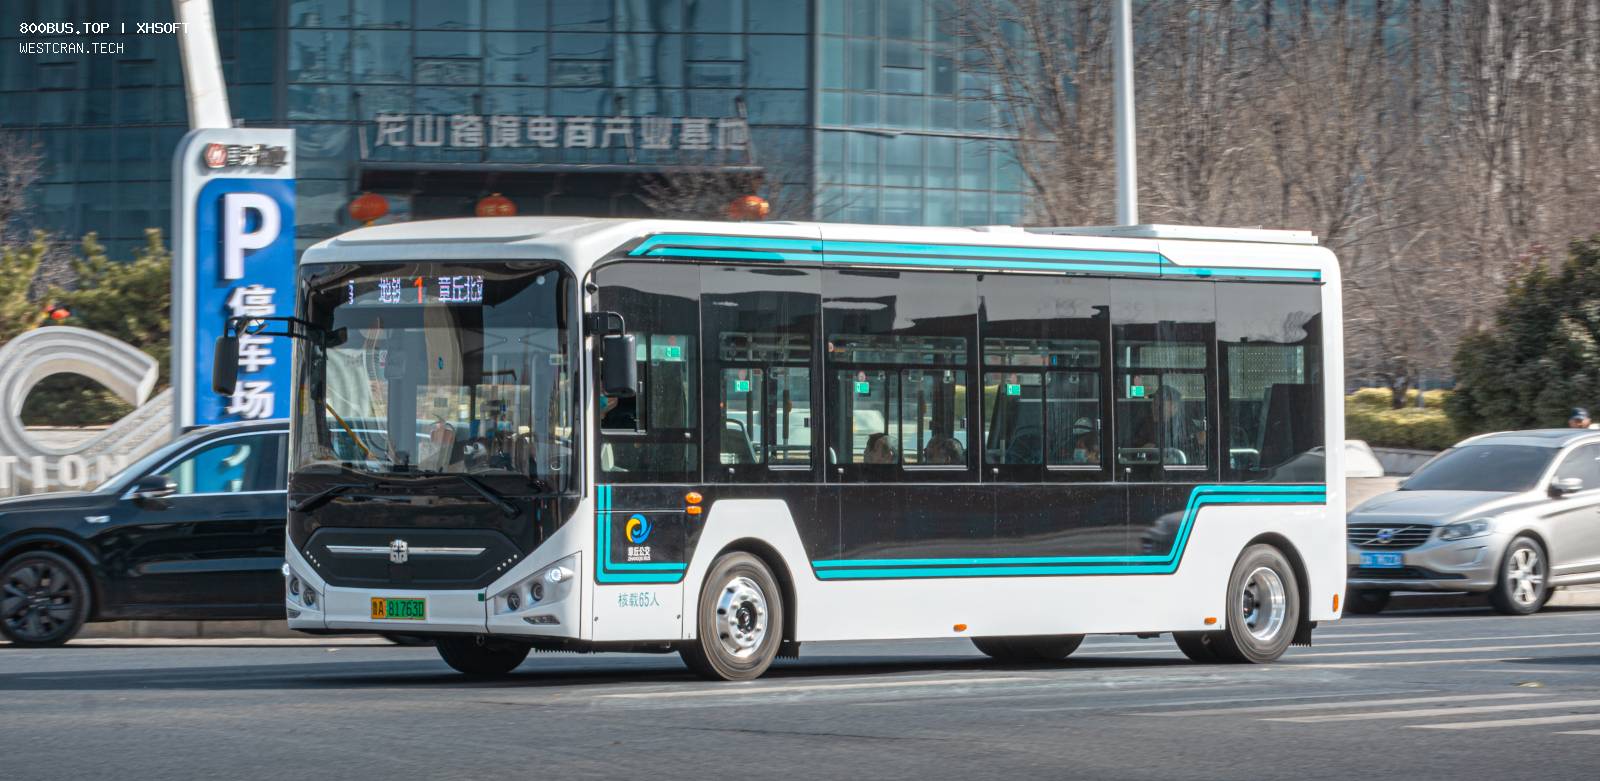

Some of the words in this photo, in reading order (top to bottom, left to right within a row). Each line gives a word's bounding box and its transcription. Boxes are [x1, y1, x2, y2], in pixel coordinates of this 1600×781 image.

[375, 112, 747, 150] 龙山跨境电商产业基地
[223, 192, 282, 280] P
[414, 275, 424, 304] 1
[226, 284, 277, 419] 停车场
[618, 592, 660, 608] 核载65人
